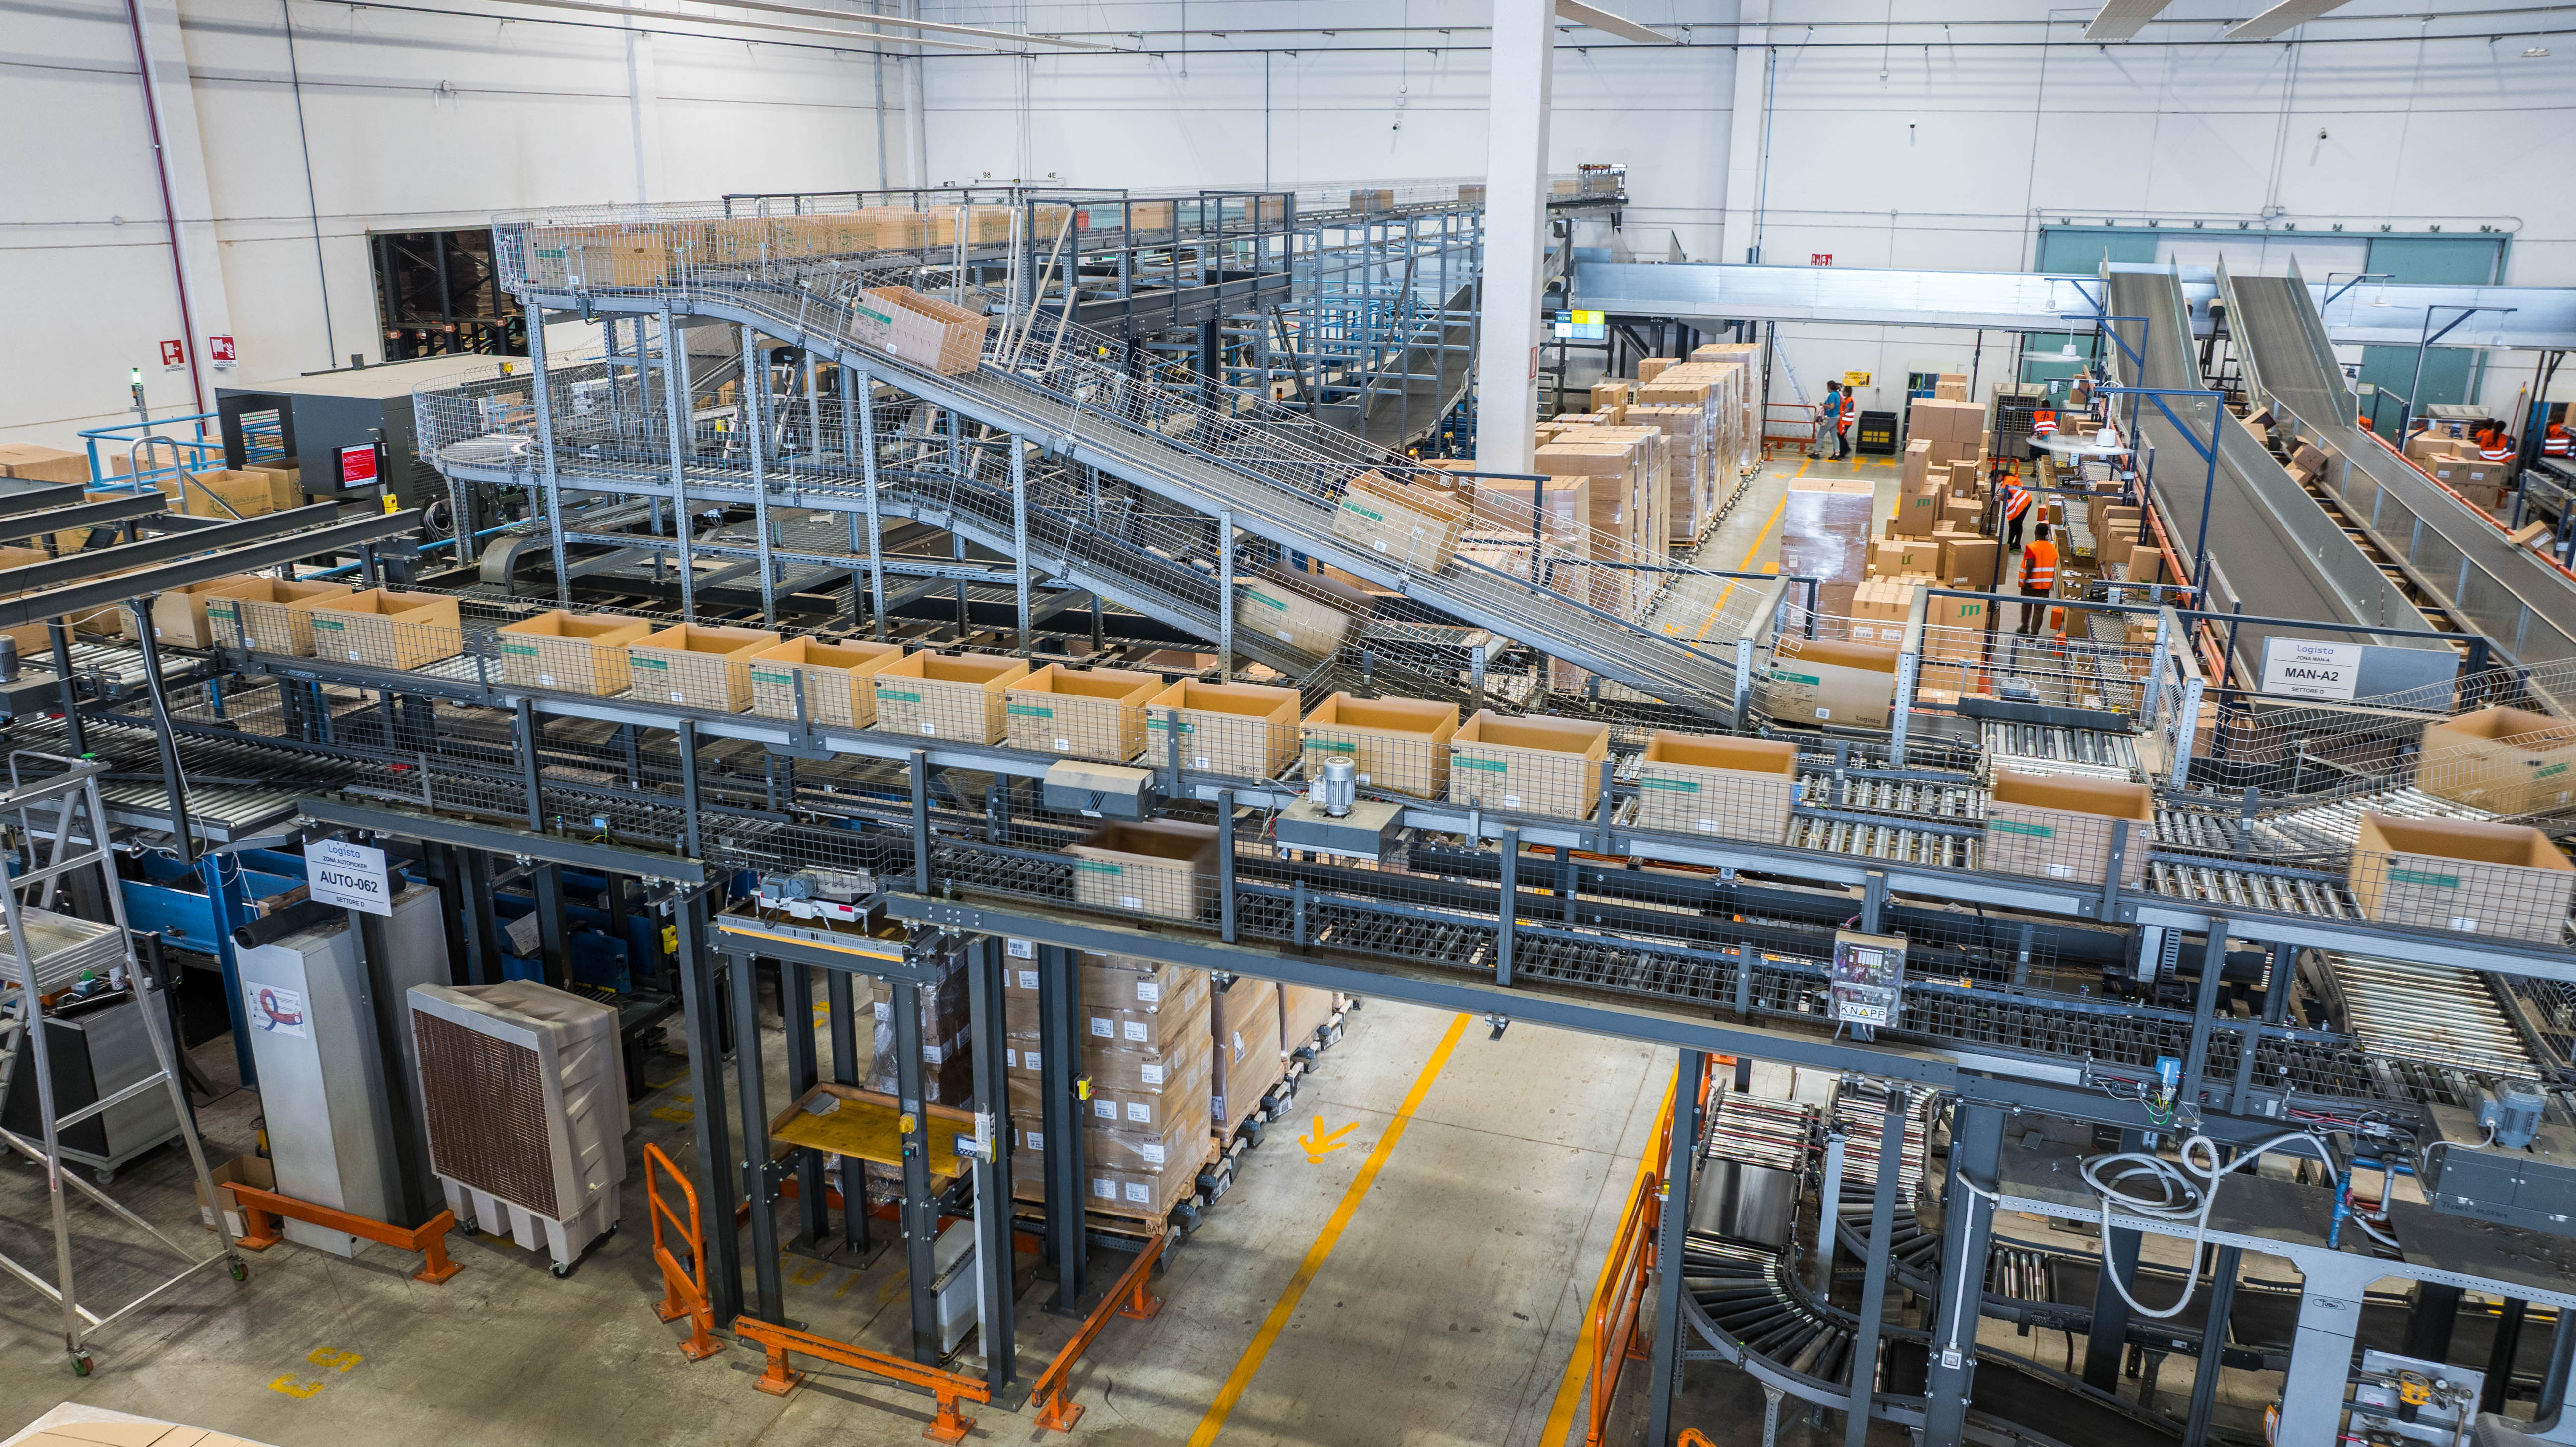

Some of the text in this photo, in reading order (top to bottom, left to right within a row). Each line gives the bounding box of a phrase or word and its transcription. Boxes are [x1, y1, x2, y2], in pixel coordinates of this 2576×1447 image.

[2285, 667, 2339, 681] MAN-A2
[337, 859, 368, 869] AUTOPICKER
[321, 871, 378, 893] AUTO-062
[336, 896, 360, 906] SETTORE
[1147, 1224, 1160, 1233] BAT
